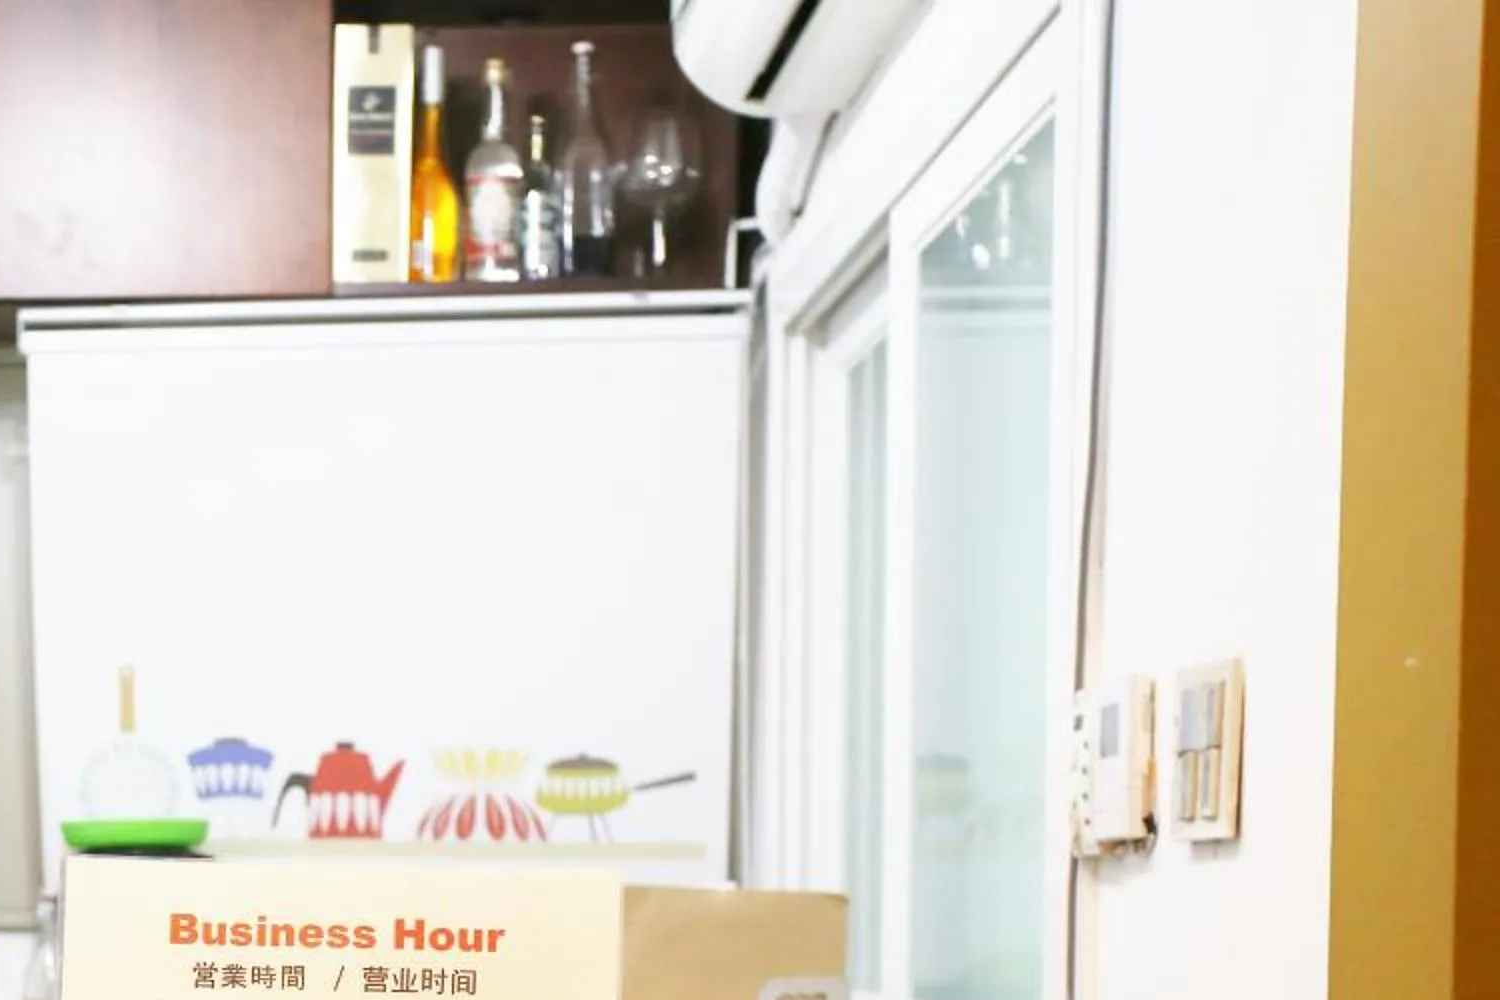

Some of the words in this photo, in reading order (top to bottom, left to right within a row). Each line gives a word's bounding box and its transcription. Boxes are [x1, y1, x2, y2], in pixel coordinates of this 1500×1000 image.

[169, 913, 377, 950] Business
[393, 918, 506, 953] Hour
[362, 965, 478, 996] 营业时间
